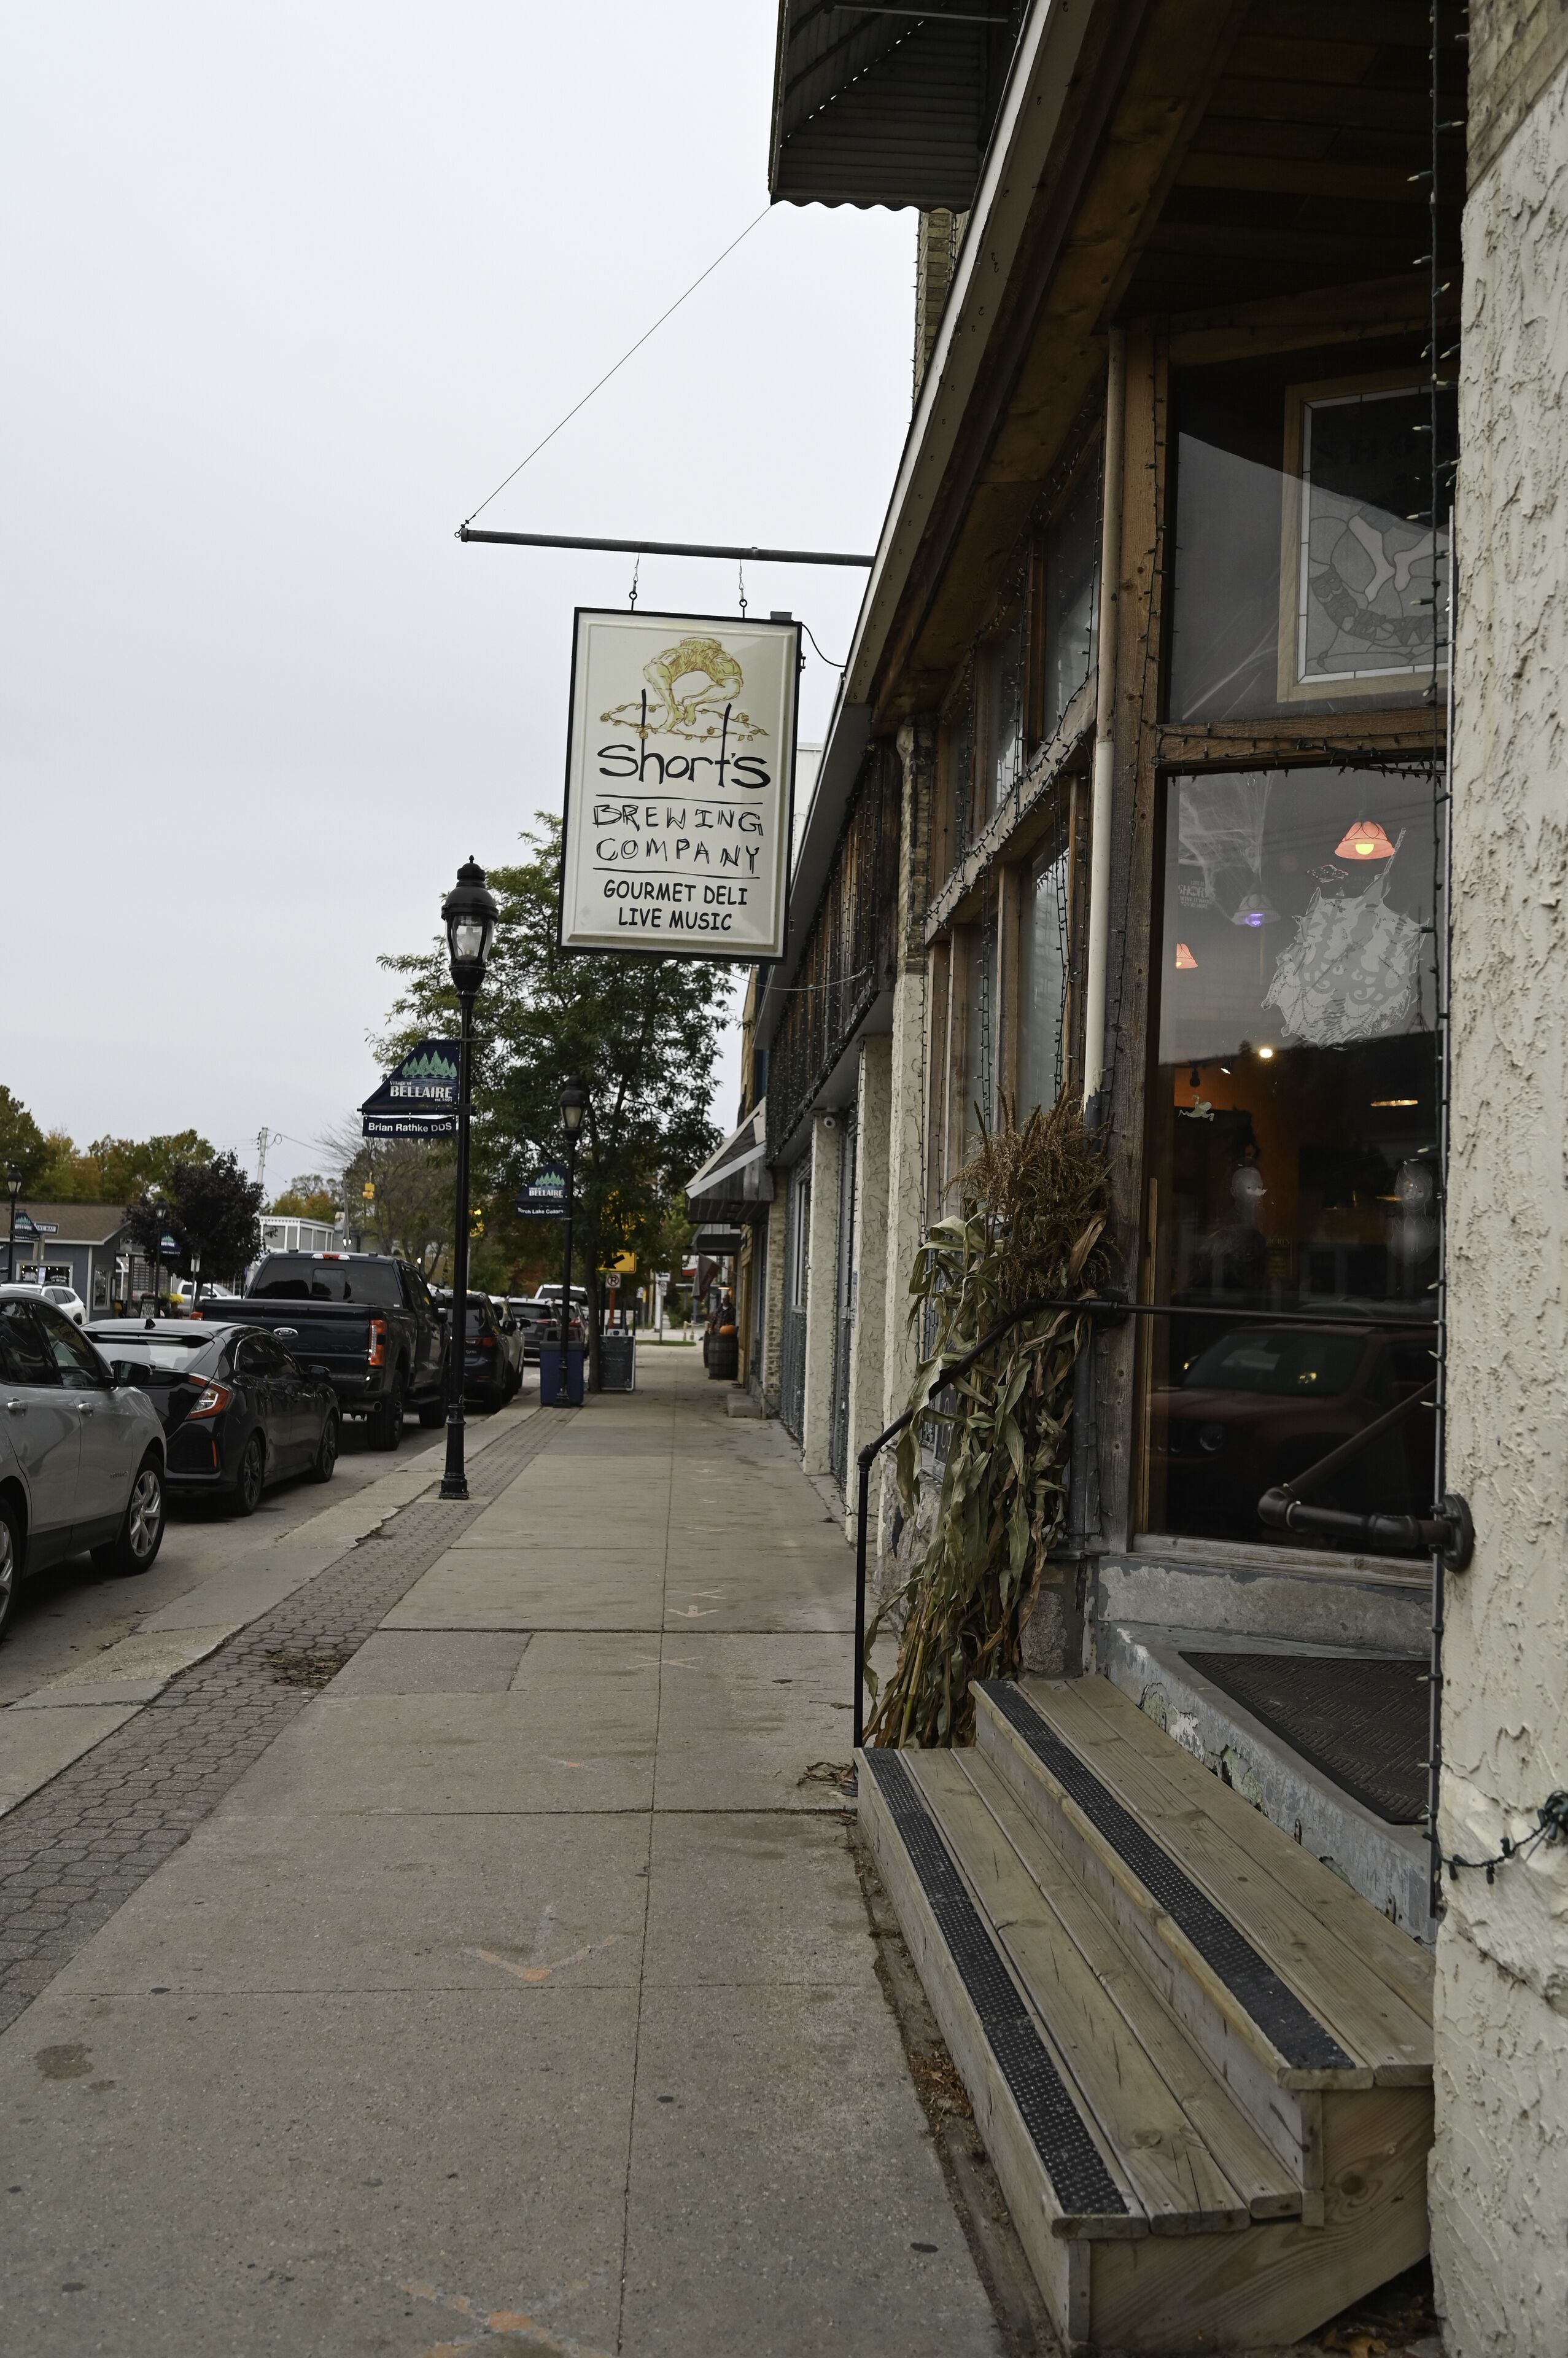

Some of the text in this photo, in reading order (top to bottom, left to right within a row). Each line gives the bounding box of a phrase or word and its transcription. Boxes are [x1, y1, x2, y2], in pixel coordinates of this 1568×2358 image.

[597, 688, 771, 789] Short's
[592, 804, 764, 836] BREWING
[596, 838, 760, 874] COMPANY
[604, 879, 748, 906] GOURMET DELI
[618, 907, 732, 931] LIVE MUSIC
[390, 1086, 452, 1098] BELLAIRE
[368, 1122, 452, 1132] Brian Rathke DDS
